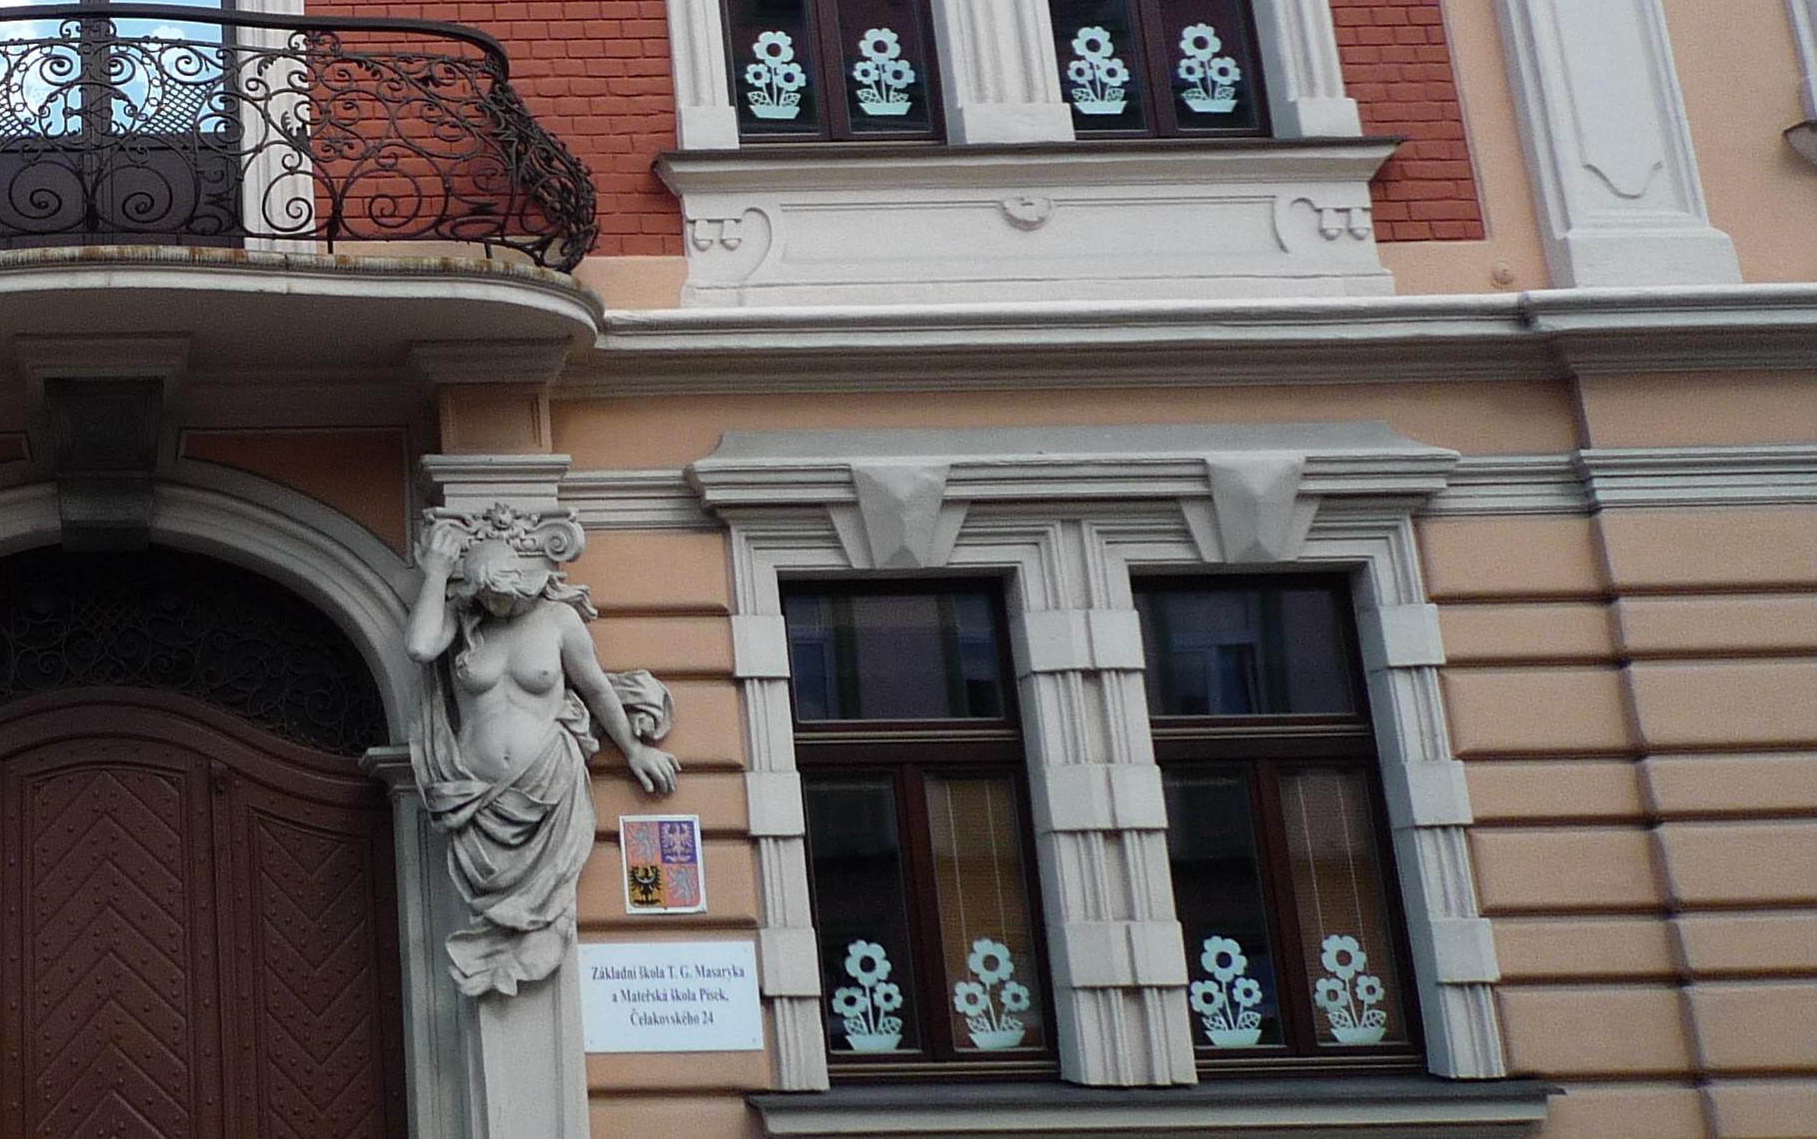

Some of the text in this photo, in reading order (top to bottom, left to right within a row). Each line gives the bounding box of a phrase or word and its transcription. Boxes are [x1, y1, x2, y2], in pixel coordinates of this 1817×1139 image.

[591, 964, 745, 980] Základní škola T. G. Masaryka
[612, 993, 618, 1003] a
[622, 989, 668, 1003] Mateřská
[671, 988, 696, 1002] škola
[630, 1009, 713, 1026] Čelakovského 24
